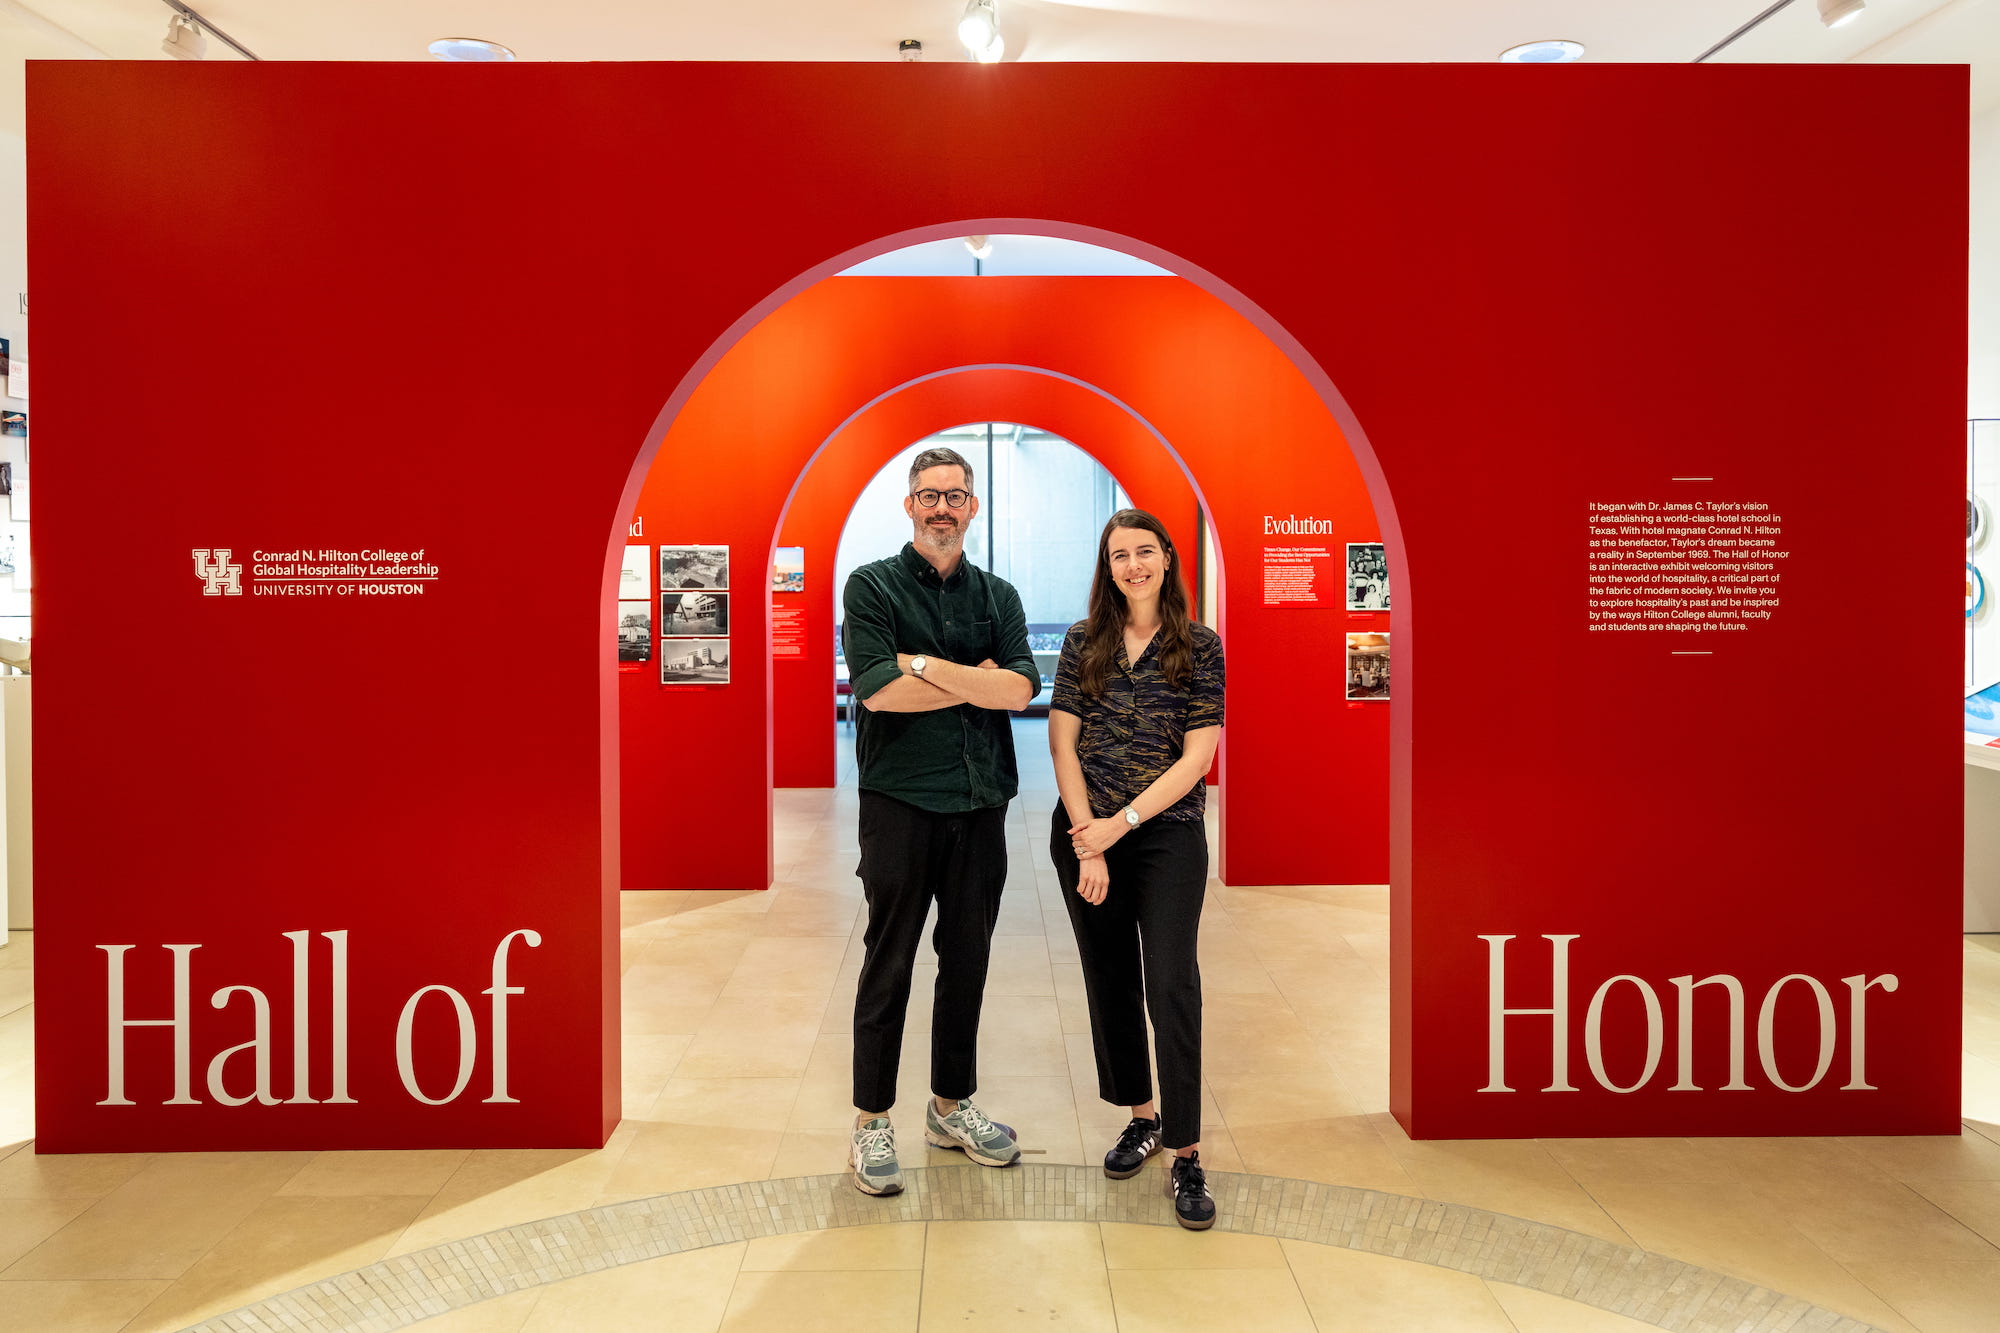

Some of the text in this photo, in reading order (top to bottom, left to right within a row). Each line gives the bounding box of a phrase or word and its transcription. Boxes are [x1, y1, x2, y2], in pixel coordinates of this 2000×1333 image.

[1589, 502, 1596, 510] It
[1597, 502, 1626, 513] began
[1627, 502, 1646, 510] with
[1648, 502, 1661, 510] Dr.
[1662, 502, 1693, 511] James
[1694, 502, 1704, 510] C.
[1742, 502, 1768, 510] vision
[1589, 514, 1599, 523] of
[1600, 514, 1654, 524] establishing
[1663, 514, 1716, 522] world-class
[1716, 514, 1740, 522] hotel
[1740, 514, 1771, 522] school
[1772, 514, 1781, 522] in
[1263, 515, 1333, 535] Evolution
[1589, 526, 1781, 536] Texas. With hotel magnate Conrad N. Hilton
[1601, 538, 1617, 547] the
[1618, 538, 1670, 547] benefactor,
[1707, 538, 1737, 546] dream
[1738, 538, 1775, 546] became
[253, 549, 424, 563] Conrad N. Hilton College of
[1597, 550, 1625, 561] reality
[1626, 550, 1634, 559] in
[1636, 550, 1686, 560] September
[1688, 550, 1711, 558] 1969.
[1712, 550, 1730, 558] The
[1732, 550, 1749, 558] Hall
[1750, 550, 1760, 558] of
[1762, 550, 1790, 558] Honor
[253, 563, 439, 577] Global Hospitality Leadership
[1589, 562, 1597, 571] is
[1612, 562, 1659, 571] interactive
[1660, 562, 1690, 571] exhibit
[1691, 562, 1740, 572] welcoming
[1742, 562, 1774, 570] visitors
[1589, 574, 1607, 583] into
[1608, 574, 1623, 583] the
[1624, 574, 1650, 583] world
[1651, 574, 1661, 583] of
[1662, 574, 1710, 584] hospitality,
[1718, 574, 1749, 582] critical
[1750, 574, 1769, 584] part
[1770, 574, 1780, 582] of
[254, 584, 423, 596] UNIVERSITY OF HOUSTON
[1589, 586, 1776, 596] the fabric of modern society. We invite you
[1589, 599, 1599, 607] to
[1600, 598, 1634, 608] explore
[1689, 599, 1709, 608] past
[1710, 598, 1728, 606] and
[1730, 598, 1742, 606] be
[1743, 598, 1779, 608] inspired
[1589, 610, 1771, 621] by the ways Hilton College alumni, faculty
[1589, 622, 1607, 631] and
[1608, 622, 1648, 631] students
[1665, 622, 1701, 632] shaping
[1702, 622, 1718, 630] the
[1719, 622, 1748, 630] future.
[96, 929, 1899, 1106] Hall of Honor
